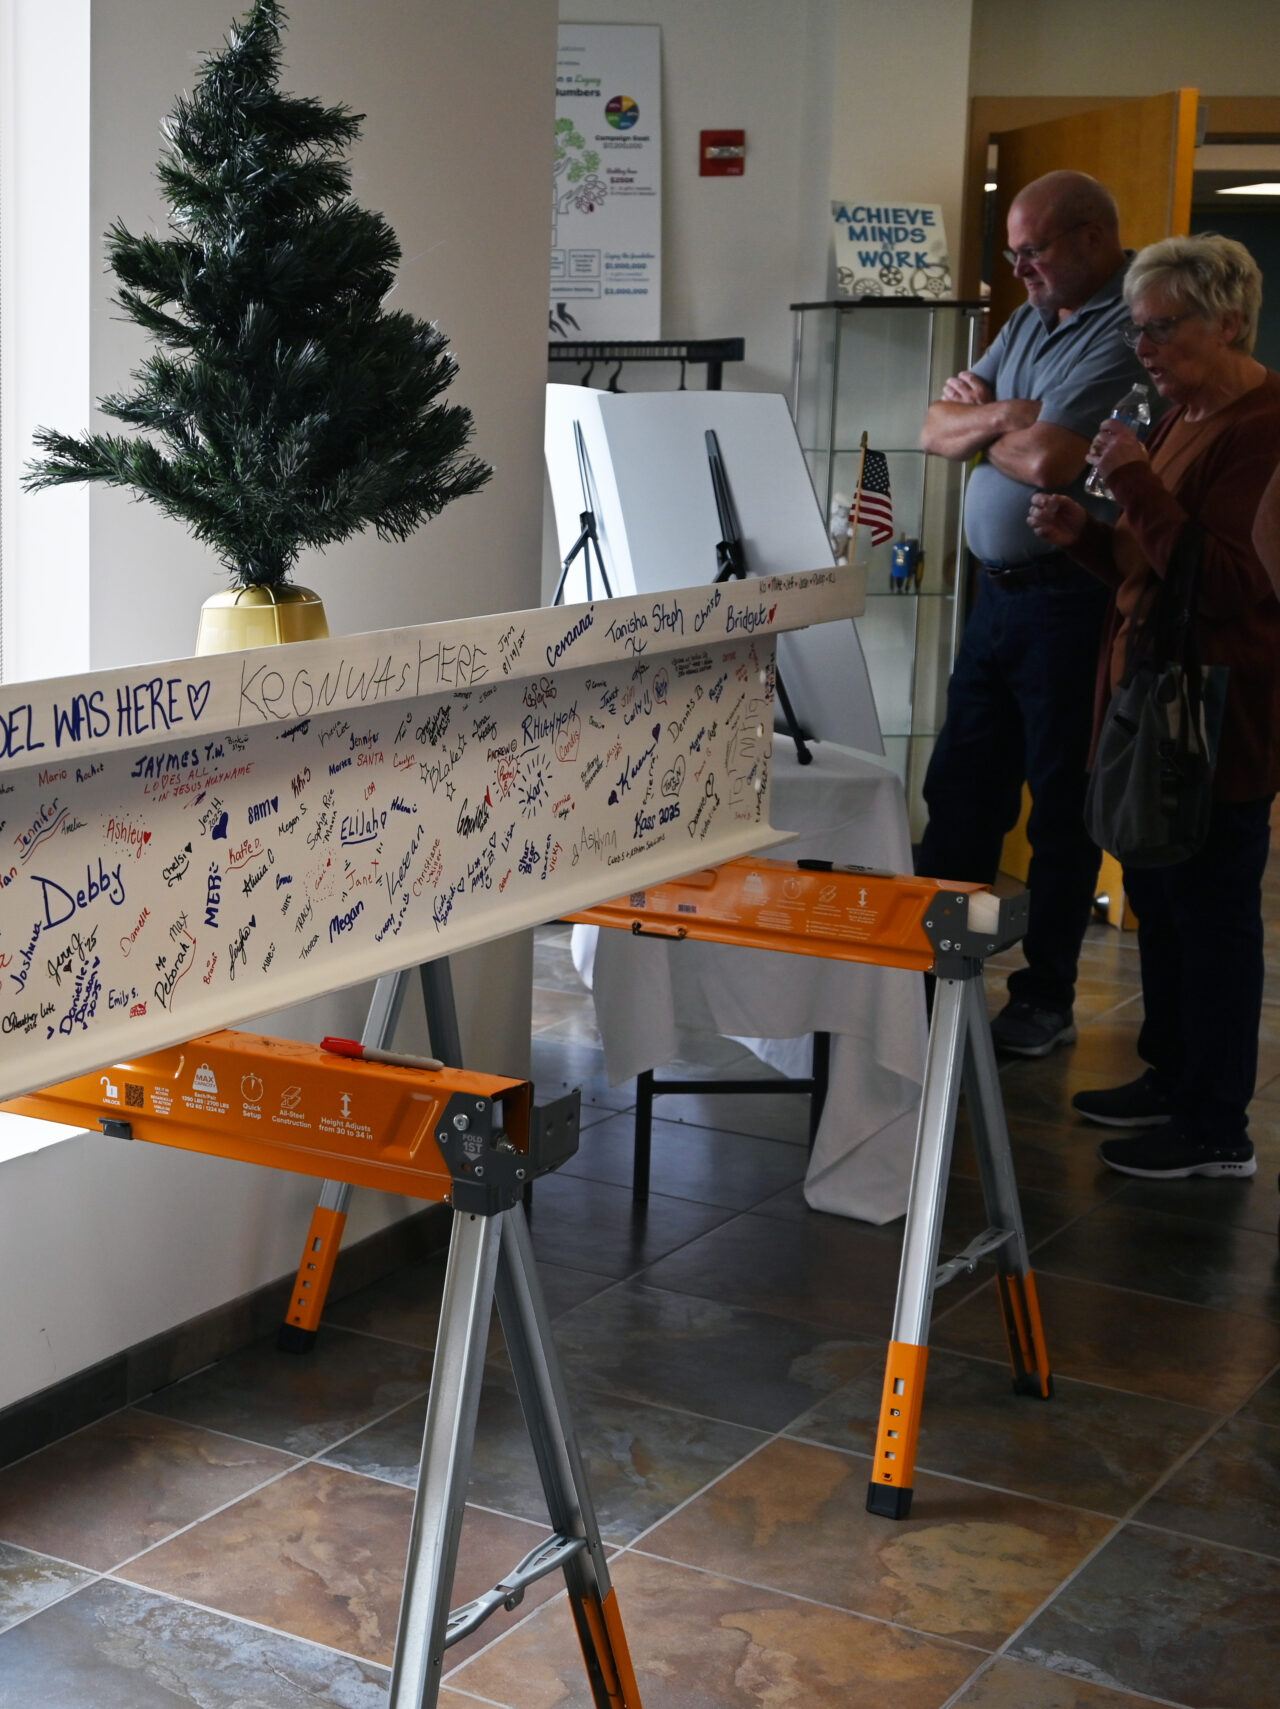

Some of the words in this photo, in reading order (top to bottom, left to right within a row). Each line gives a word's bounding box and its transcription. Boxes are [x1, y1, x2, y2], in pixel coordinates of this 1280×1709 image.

[835, 206, 936, 226] ACHIEVE
[848, 225, 926, 244] MINDS
[857, 250, 931, 269] WORK
[725, 606, 768, 633] Bridget
[417, 641, 489, 697] HERE
[52, 690, 111, 749] WAS
[116, 677, 183, 738] HERE
[667, 699, 696, 744] Dennis
[348, 729, 380, 750] Jennifer
[131, 749, 200, 778] JAYMES
[356, 752, 385, 767] SANTA
[157, 791, 170, 803] IN
[173, 782, 202, 798] JESUS
[225, 762, 255, 782] NAME
[188, 767, 209, 780] ALL
[200, 804, 215, 836] Jen
[248, 799, 272, 825] SAM
[658, 801, 681, 826] 2025
[13, 797, 60, 854] Jennifer
[278, 815, 300, 837] Megan
[106, 818, 144, 860] Ashley
[549, 841, 564, 872] VICKY
[30, 857, 126, 931] Debby
[119, 907, 151, 958] Danielle
[169, 910, 189, 942] Max
[329, 900, 365, 943] Megan
[154, 942, 190, 1009] Deborah
[108, 989, 130, 1010] Emily
[194, 1079, 217, 1090] CAPACITY
[196, 1073, 215, 1084] MAX
[242, 1109, 262, 1120] Setup
[243, 1102, 262, 1113] Quick
[279, 1109, 305, 1120] All-Steel
[271, 1116, 312, 1129] Construction
[319, 1123, 335, 1133] from
[335, 1126, 346, 1135] 30
[346, 1127, 355, 1136] to
[366, 1131, 374, 1140] in
[321, 1117, 345, 1129] Height
[345, 1119, 372, 1133] Adjusts
[462, 1134, 483, 1143] FOLD
[463, 1141, 484, 1153] 1ST
